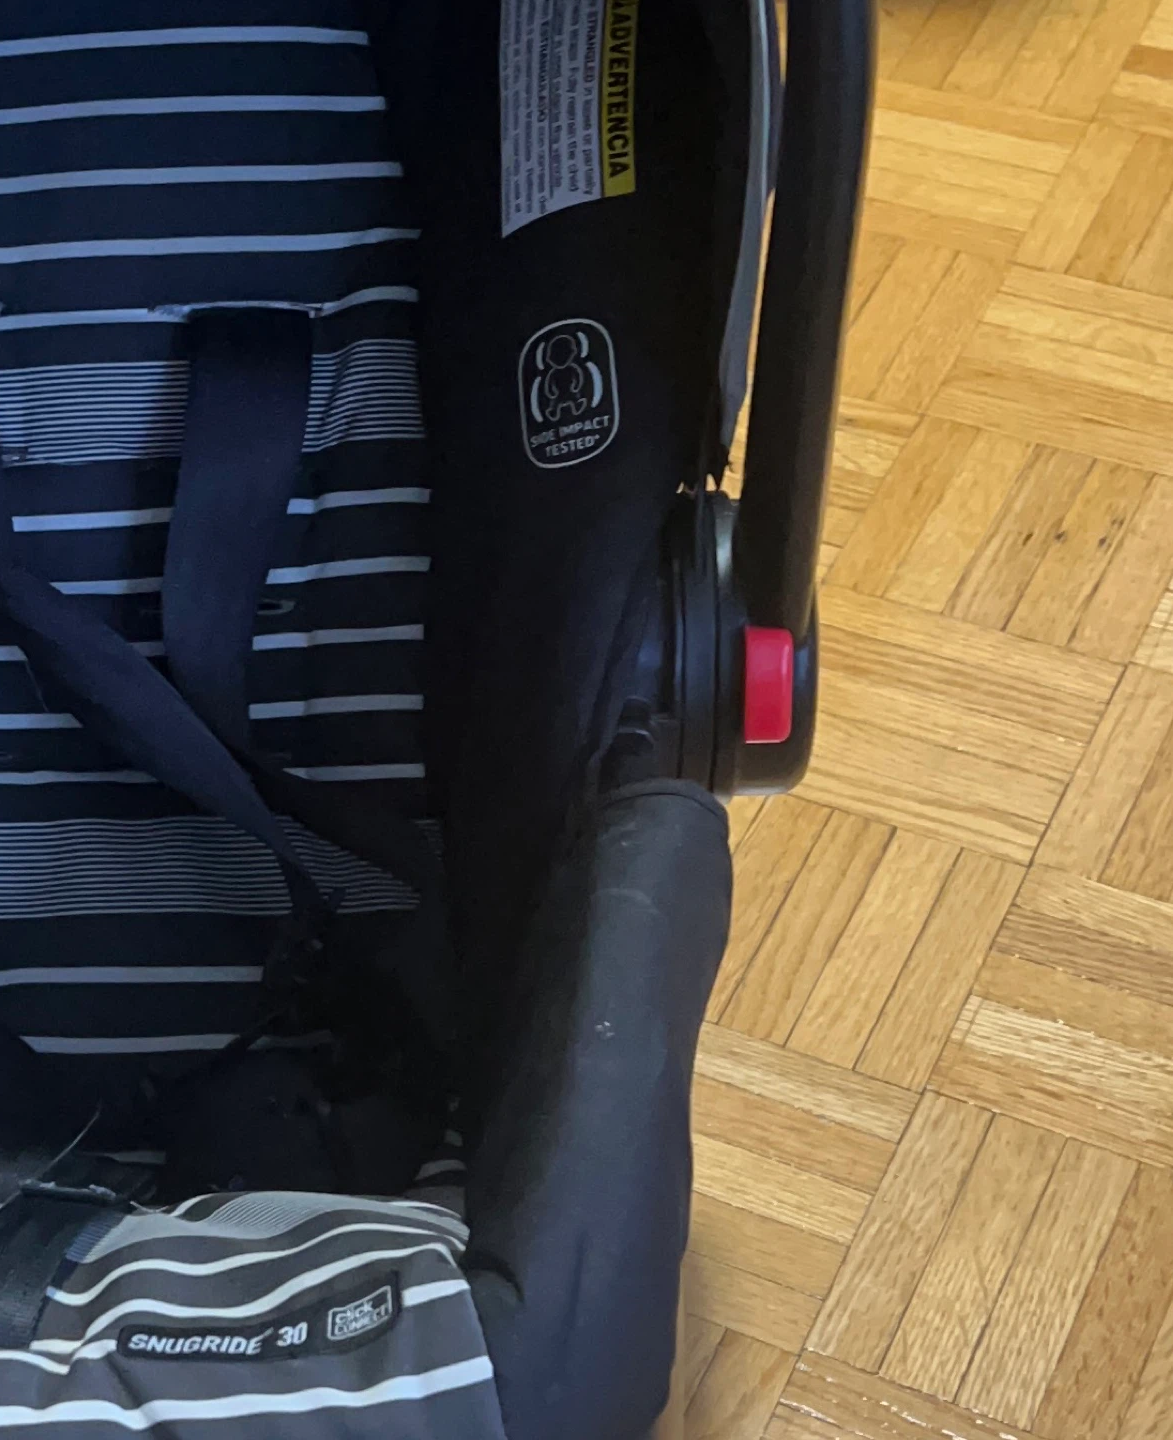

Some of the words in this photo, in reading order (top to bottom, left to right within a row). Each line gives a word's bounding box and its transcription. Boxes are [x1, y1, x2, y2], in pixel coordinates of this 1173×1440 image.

[607, 12, 629, 178] ADVERTENCIA
[559, 415, 610, 437] IMPACT
[276, 1321, 308, 1347] 30
